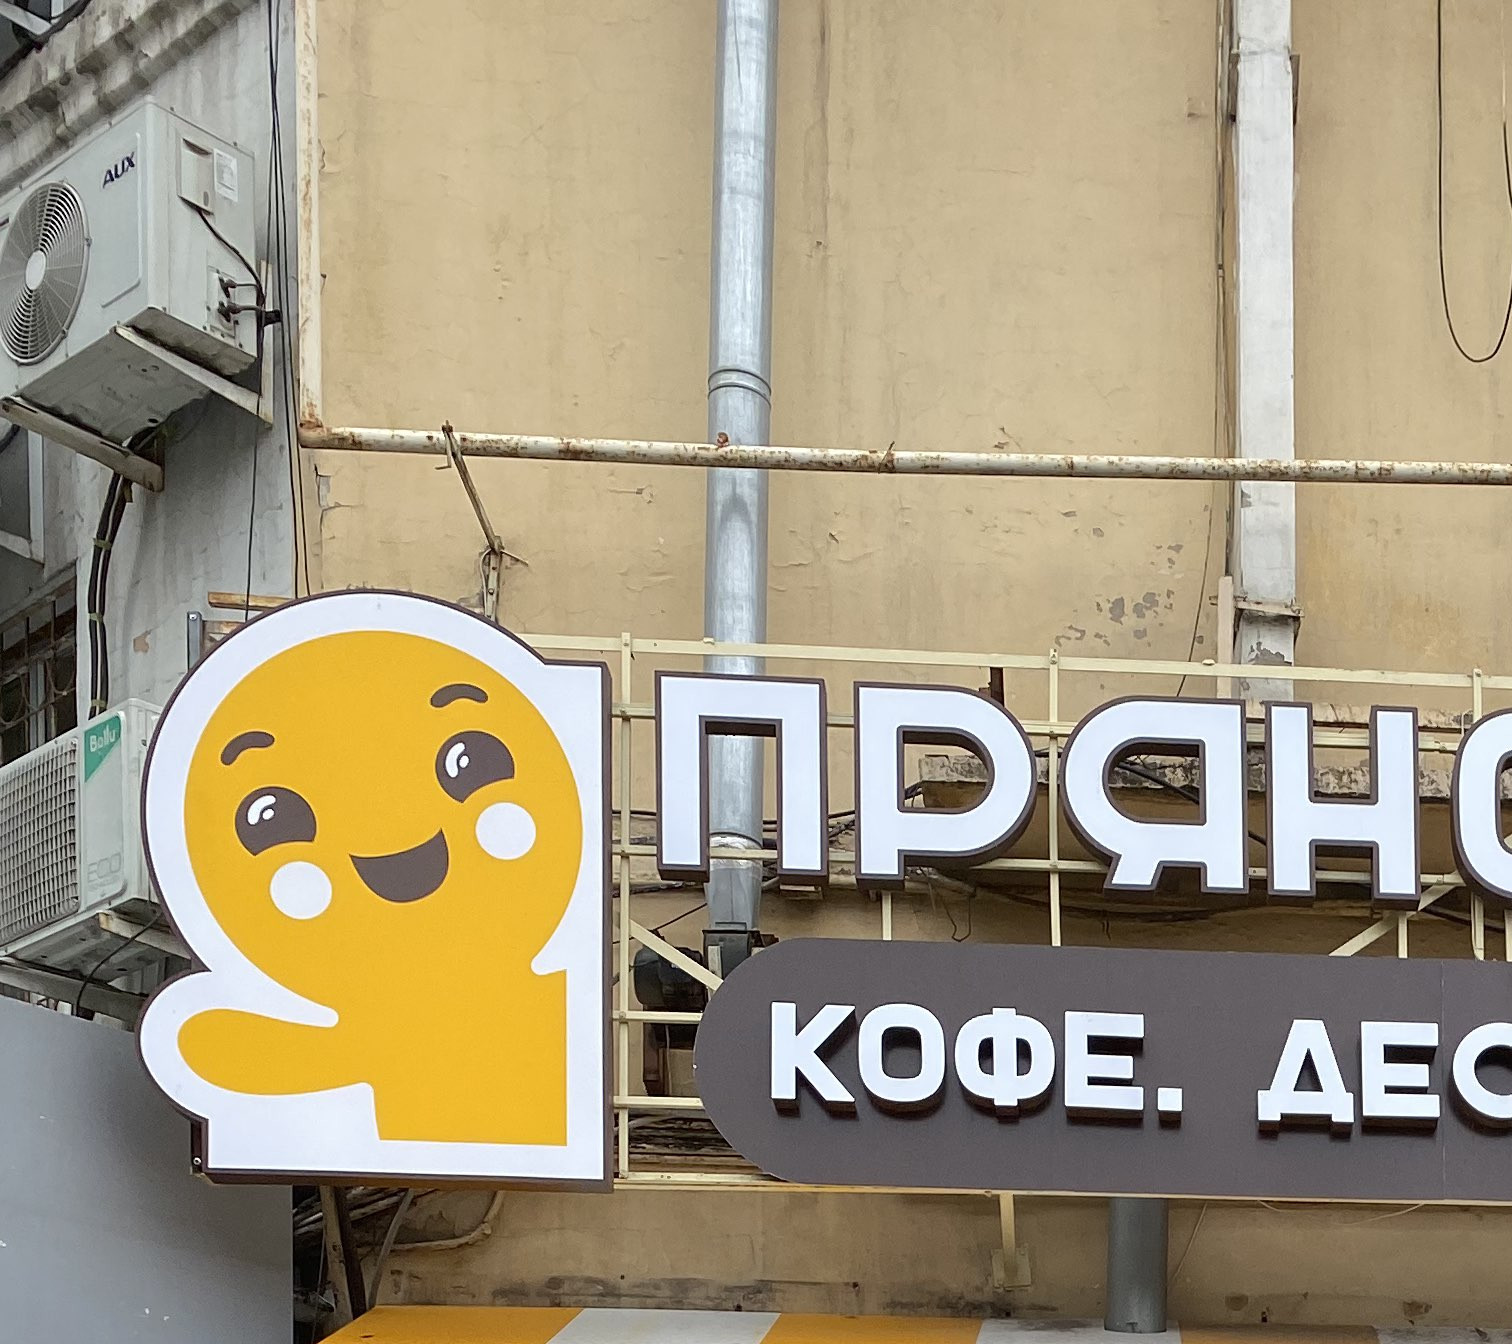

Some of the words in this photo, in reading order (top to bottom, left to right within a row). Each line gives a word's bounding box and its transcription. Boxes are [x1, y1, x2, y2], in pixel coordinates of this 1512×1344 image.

[102, 151, 136, 189] AUX
[87, 851, 122, 883] ECO
[769, 1000, 1183, 1116] КОФЕ.
